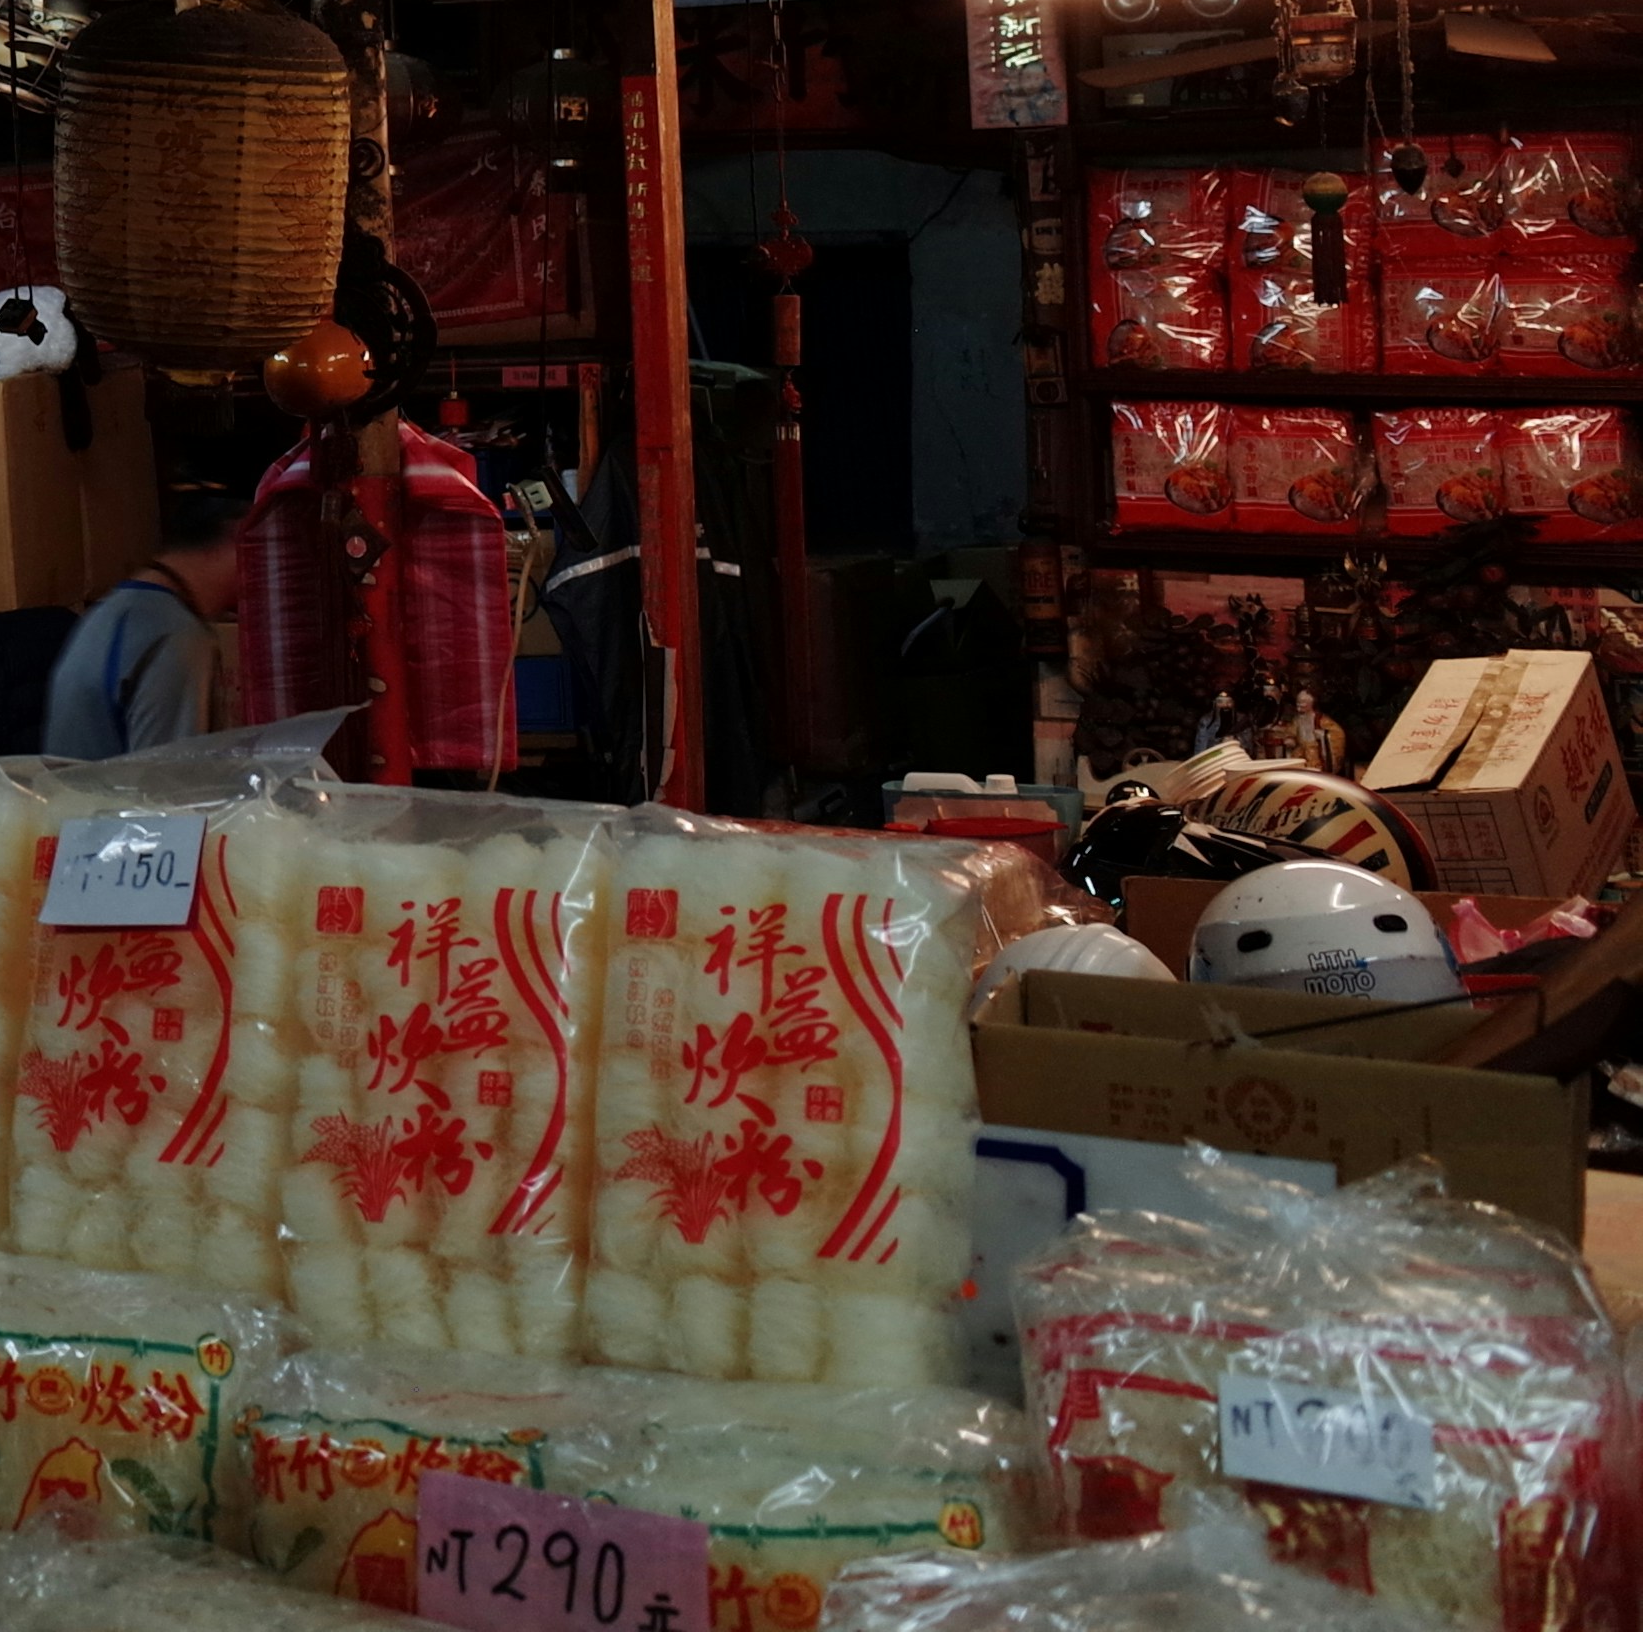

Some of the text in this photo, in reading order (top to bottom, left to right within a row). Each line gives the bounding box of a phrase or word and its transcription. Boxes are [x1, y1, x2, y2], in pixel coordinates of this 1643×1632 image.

[56, 928, 185, 1126] 益炊粉
[1304, 970, 1377, 996] MOTO
[426, 1527, 476, 1594] NT
[491, 1524, 628, 1626] 290
